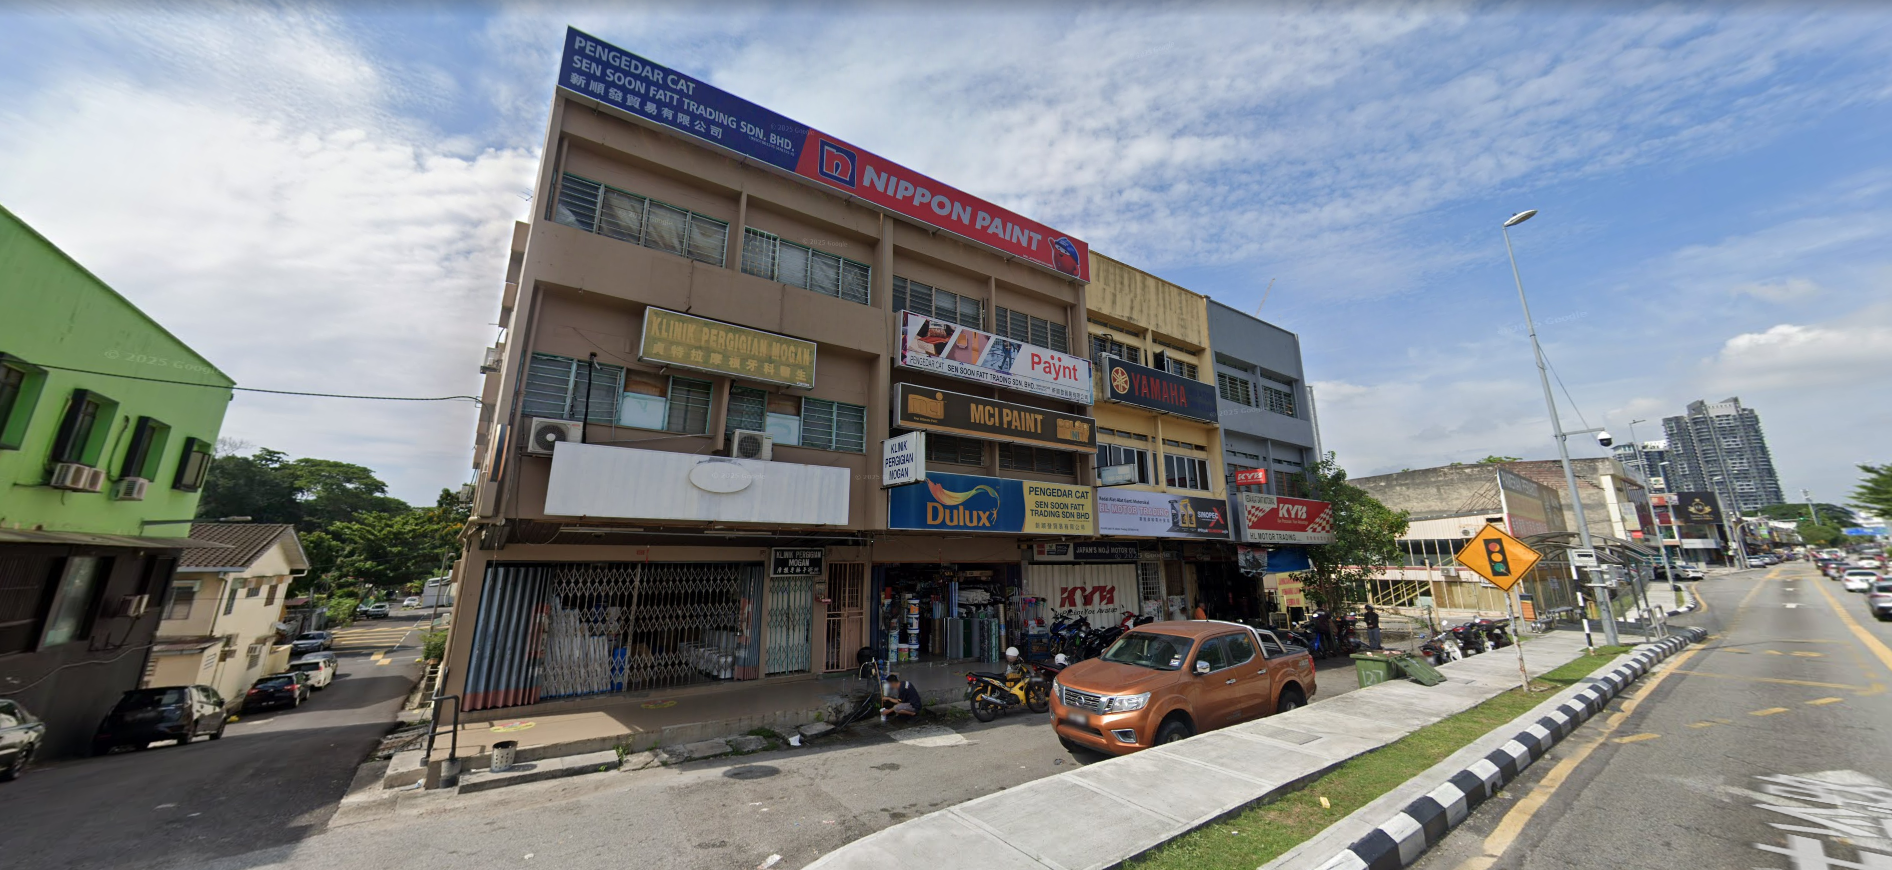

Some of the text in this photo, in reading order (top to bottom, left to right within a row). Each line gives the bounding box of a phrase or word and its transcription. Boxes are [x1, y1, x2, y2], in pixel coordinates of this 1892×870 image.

[574, 36, 696, 96] PENGEDAR CAT
[569, 71, 723, 140] 新順發貿易有限公司
[572, 55, 602, 77] SEN
[605, 69, 645, 94] SOON
[649, 86, 680, 106] FATT
[682, 98, 736, 129] TRADING
[740, 121, 767, 141] SDN.
[769, 133, 795, 152] BHD.
[862, 165, 1043, 252] NIPPON PAINT
[650, 316, 811, 366] KLINIK PERGIGIAN MOGAN
[936, 361, 945, 370] CAT
[947, 365, 959, 374] SEN
[960, 366, 975, 377] SOON
[976, 371, 988, 380] FATT
[989, 373, 1012, 385] TRADING
[1131, 372, 1188, 408] YAMAHA
[970, 402, 1043, 434] MCI PAINT
[890, 440, 908, 455] KLINIK
[885, 452, 914, 468] PERGIGIAN
[888, 467, 909, 481] MOGAN
[1238, 471, 1263, 481] KYB
[1029, 486, 1090, 500] PENGEDAR CAT
[1035, 501, 1085, 511] SEN SOON FATT
[1099, 503, 1169, 517] HL MOTOR TRADING
[1278, 503, 1307, 519] KYB
[926, 502, 992, 527] Dulux
[1030, 509, 1090, 520] TRADING SDN BHD
[1197, 511, 1219, 519] SINOPEC
[1250, 532, 1257, 540] HL
[1257, 533, 1275, 541] MOTOR
[1276, 533, 1297, 541] TRADING
[1076, 546, 1097, 554] JAPAN'S
[788, 559, 810, 567] MOGAN
[1059, 585, 1116, 608] KYB
